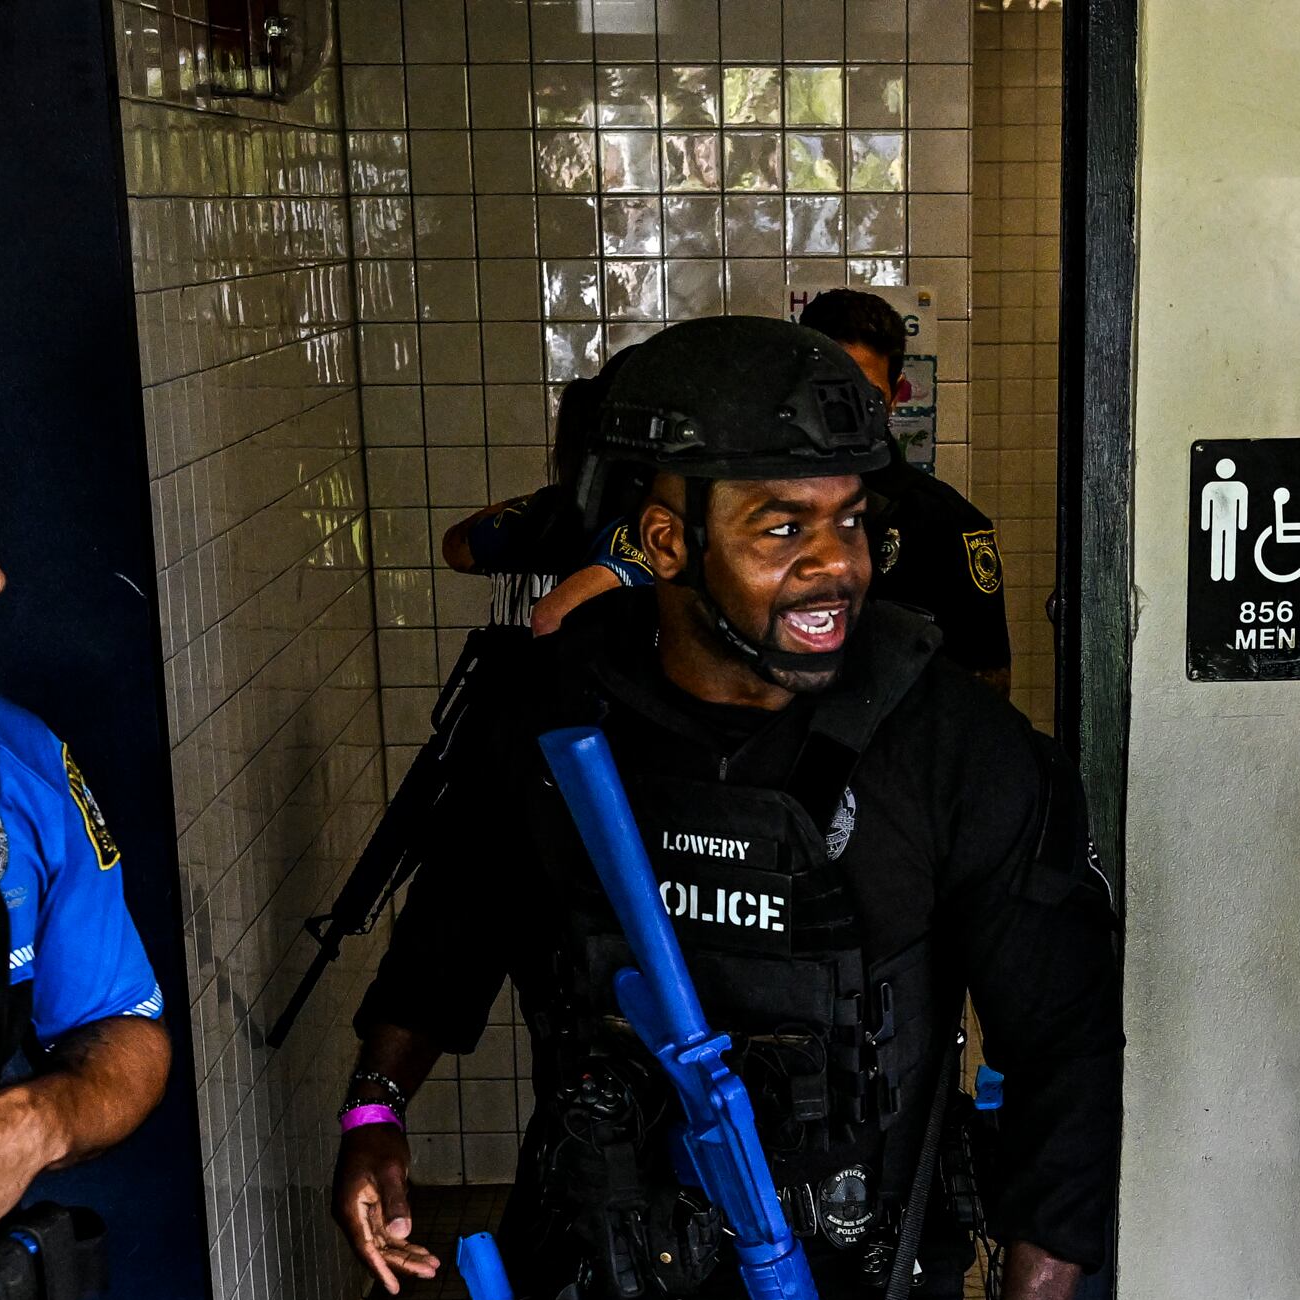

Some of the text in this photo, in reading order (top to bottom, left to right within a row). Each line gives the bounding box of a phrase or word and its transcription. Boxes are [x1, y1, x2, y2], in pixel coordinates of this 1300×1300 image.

[619, 545, 652, 566] FLORI
[1239, 600, 1294, 624] 856
[1235, 627, 1296, 650] MEN
[663, 831, 750, 860] LOWERY
[659, 881, 785, 932] OLICE
[835, 1169, 866, 1182] OFFICER
[836, 1226, 866, 1235] POLICE
